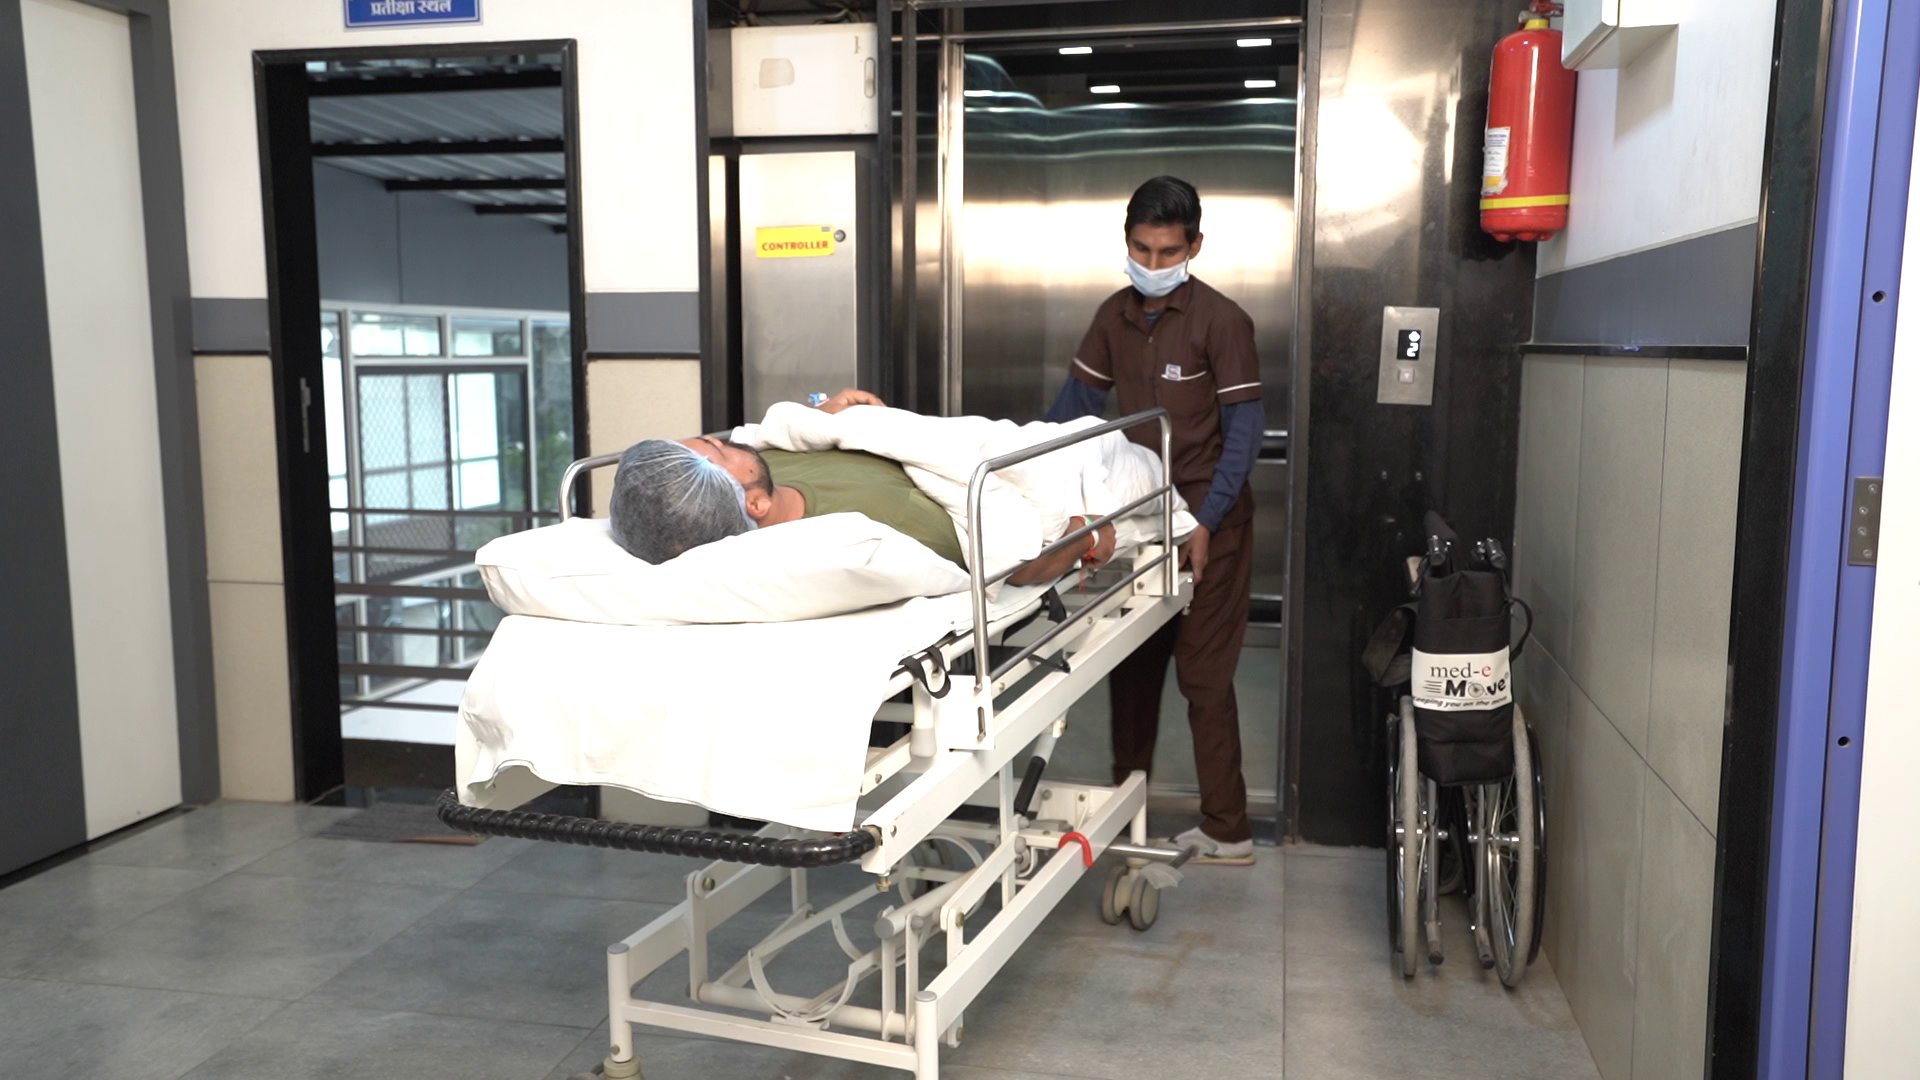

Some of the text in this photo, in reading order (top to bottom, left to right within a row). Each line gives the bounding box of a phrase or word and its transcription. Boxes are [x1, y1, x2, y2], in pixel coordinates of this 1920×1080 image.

[762, 240, 828, 251] CONTROLLER
[1406, 342, 1419, 357] 2
[1430, 662, 1492, 679] med-e
